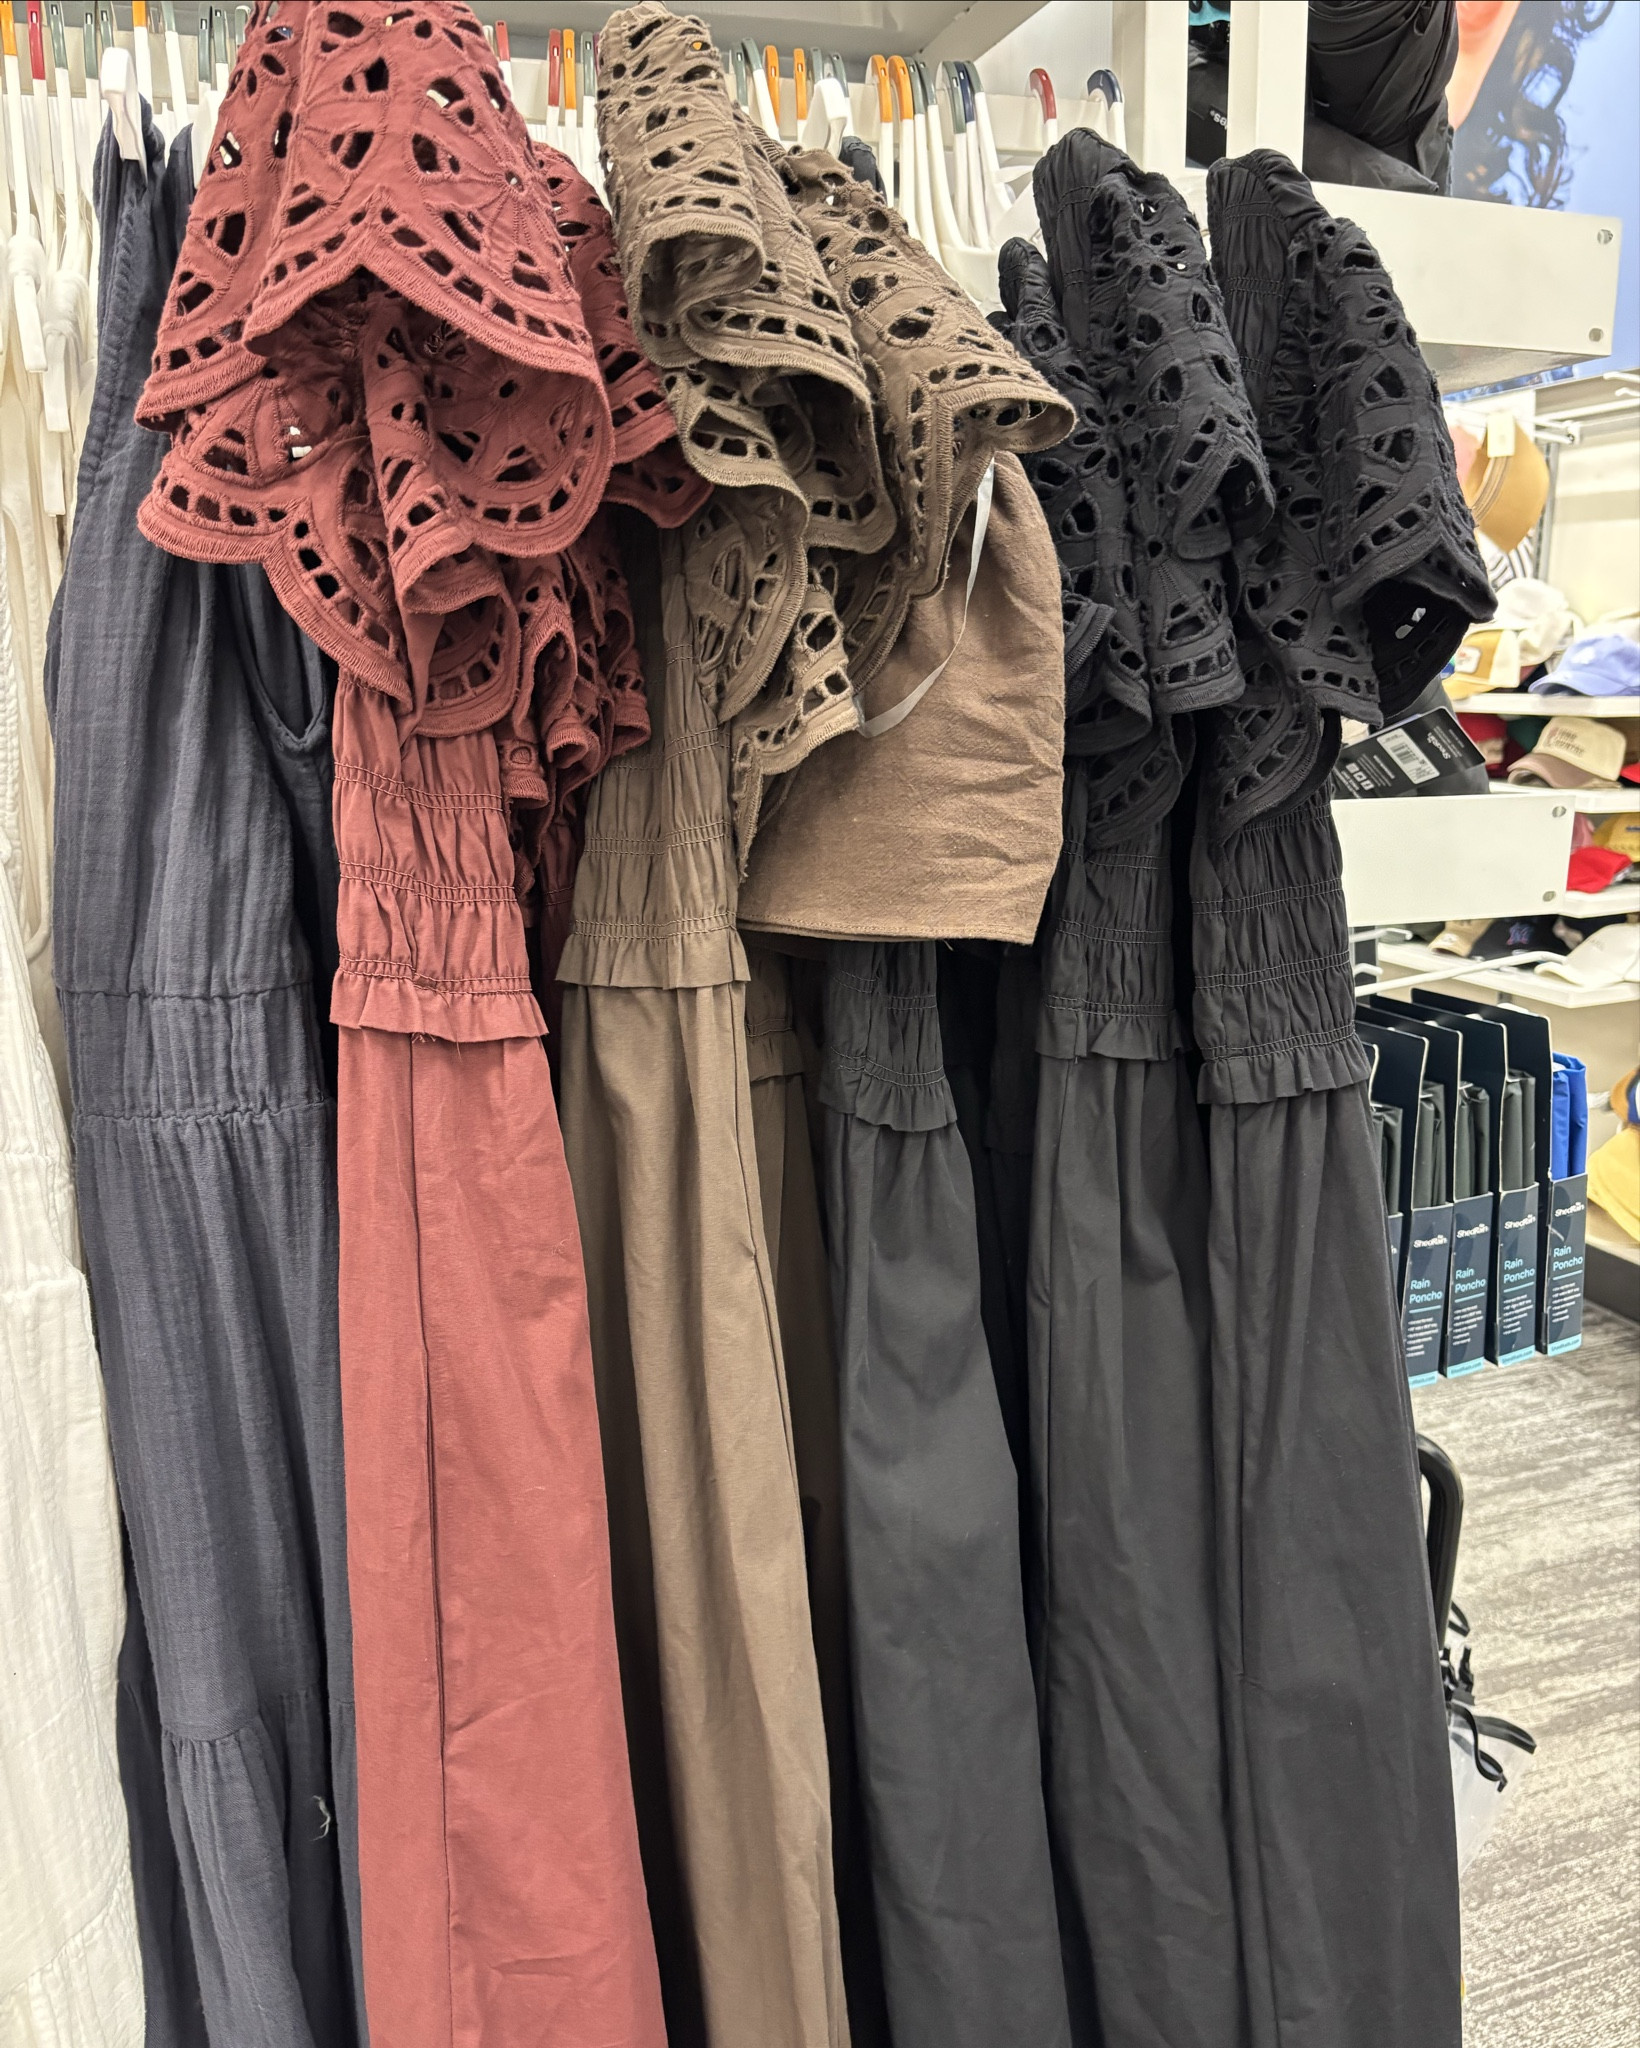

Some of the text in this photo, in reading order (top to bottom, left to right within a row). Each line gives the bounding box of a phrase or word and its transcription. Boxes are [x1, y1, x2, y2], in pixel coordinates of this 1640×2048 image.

[1553, 1245, 1571, 1258] Rain
[1504, 1258, 1523, 1270] Rain
[1553, 1256, 1583, 1271] Poncho
[1455, 1268, 1474, 1280] Rain
[1503, 1268, 1535, 1284] Poncho
[1410, 1278, 1430, 1290] Rain
[1454, 1279, 1486, 1293] Poncho
[1409, 1291, 1443, 1304] Poncho
